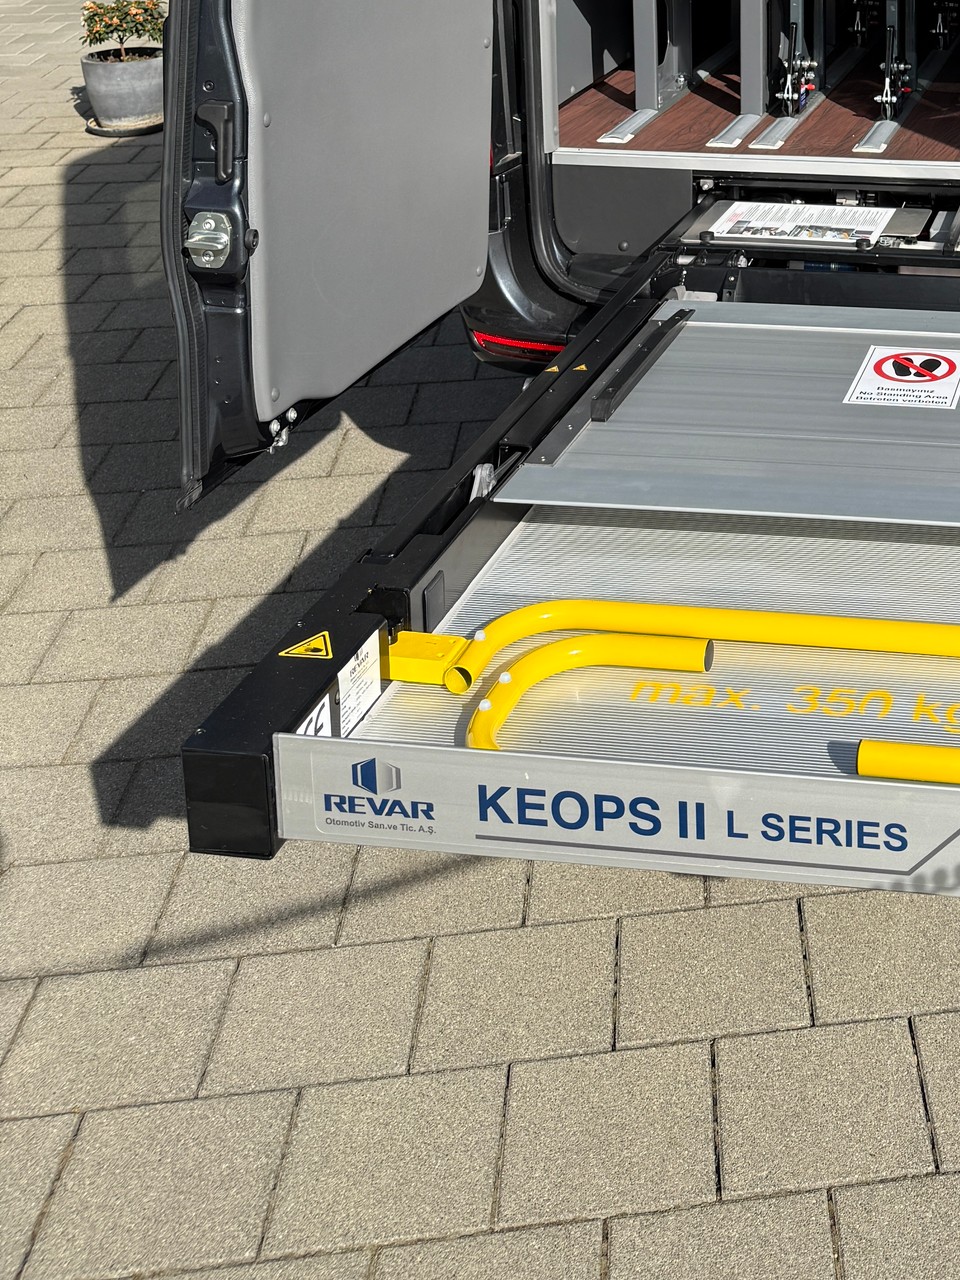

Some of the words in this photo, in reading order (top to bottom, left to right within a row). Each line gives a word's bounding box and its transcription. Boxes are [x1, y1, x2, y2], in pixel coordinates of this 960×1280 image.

[876, 391, 922, 399] Standing
[629, 680, 762, 711] max.
[323, 793, 436, 821] REVAR
[476, 783, 663, 837] KEOPS
[678, 800, 707, 841] II
[726, 810, 749, 839] L
[760, 812, 910, 852] SERIES
[325, 817, 366, 828] Otomotiv
[367, 820, 398, 831] San.ve
[399, 823, 417, 832] Tic.
[419, 825, 437, 835] A.Ş.
